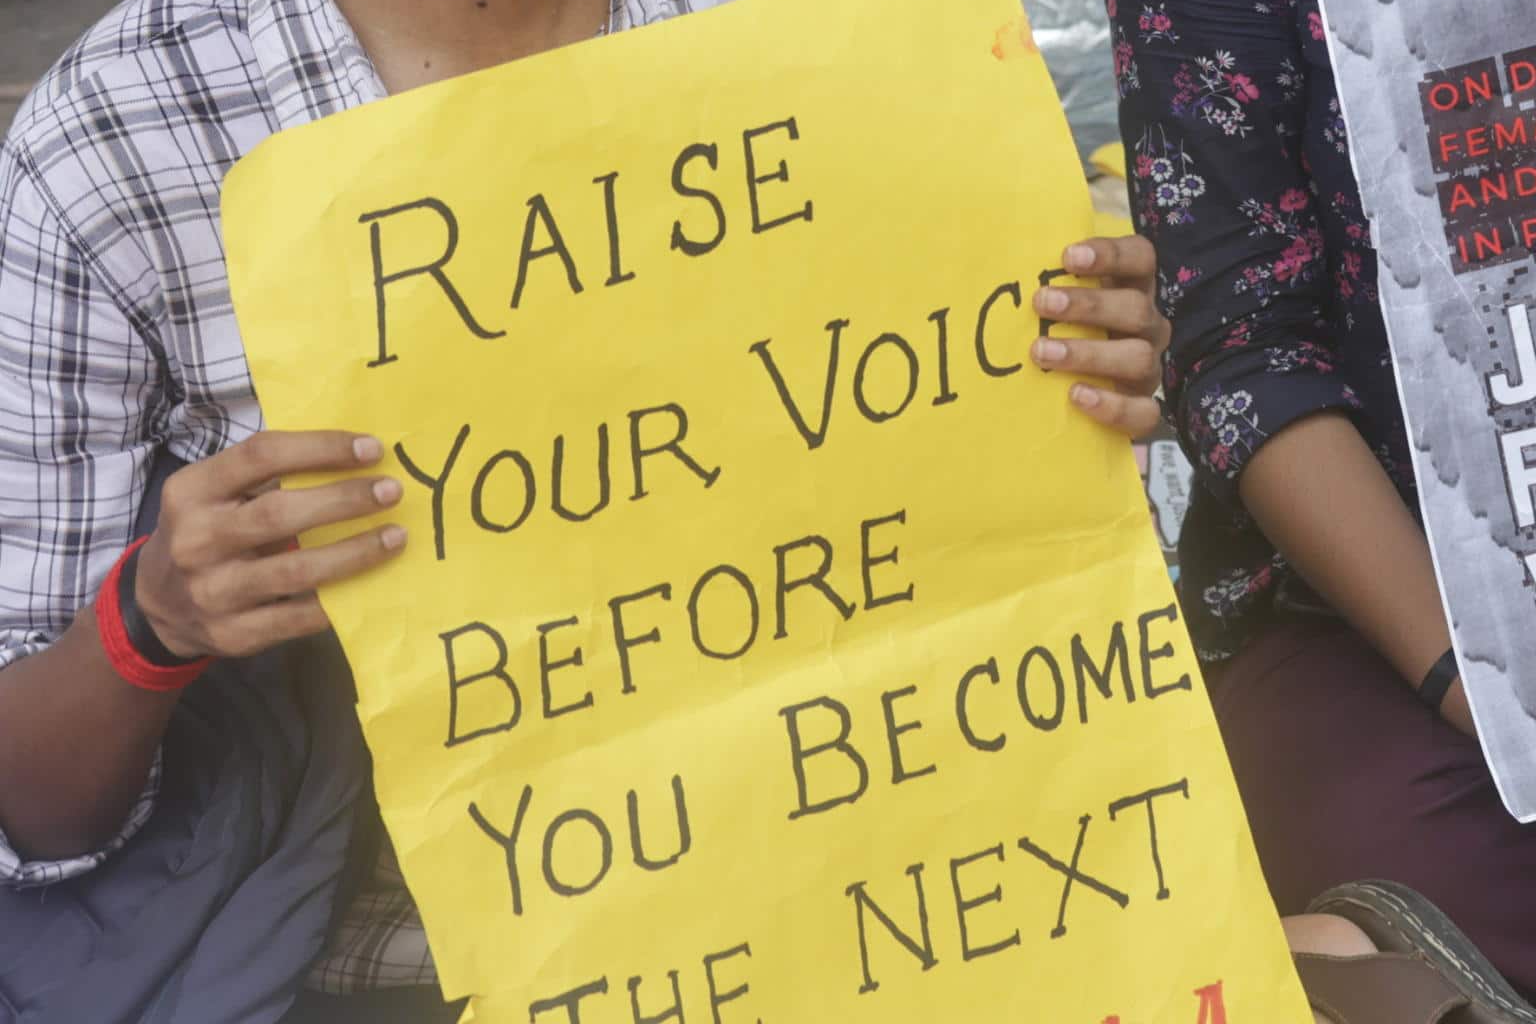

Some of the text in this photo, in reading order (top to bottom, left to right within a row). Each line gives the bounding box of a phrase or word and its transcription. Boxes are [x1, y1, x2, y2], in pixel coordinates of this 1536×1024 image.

[1429, 71, 1493, 113] ON
[357, 116, 814, 368] RAISE
[1458, 228, 1502, 264] IN
[393, 401, 722, 561] YOUR
[438, 510, 916, 748] BEFORE
[467, 602, 1194, 916] YOU BECOME
[844, 778, 1191, 995] NEXT
